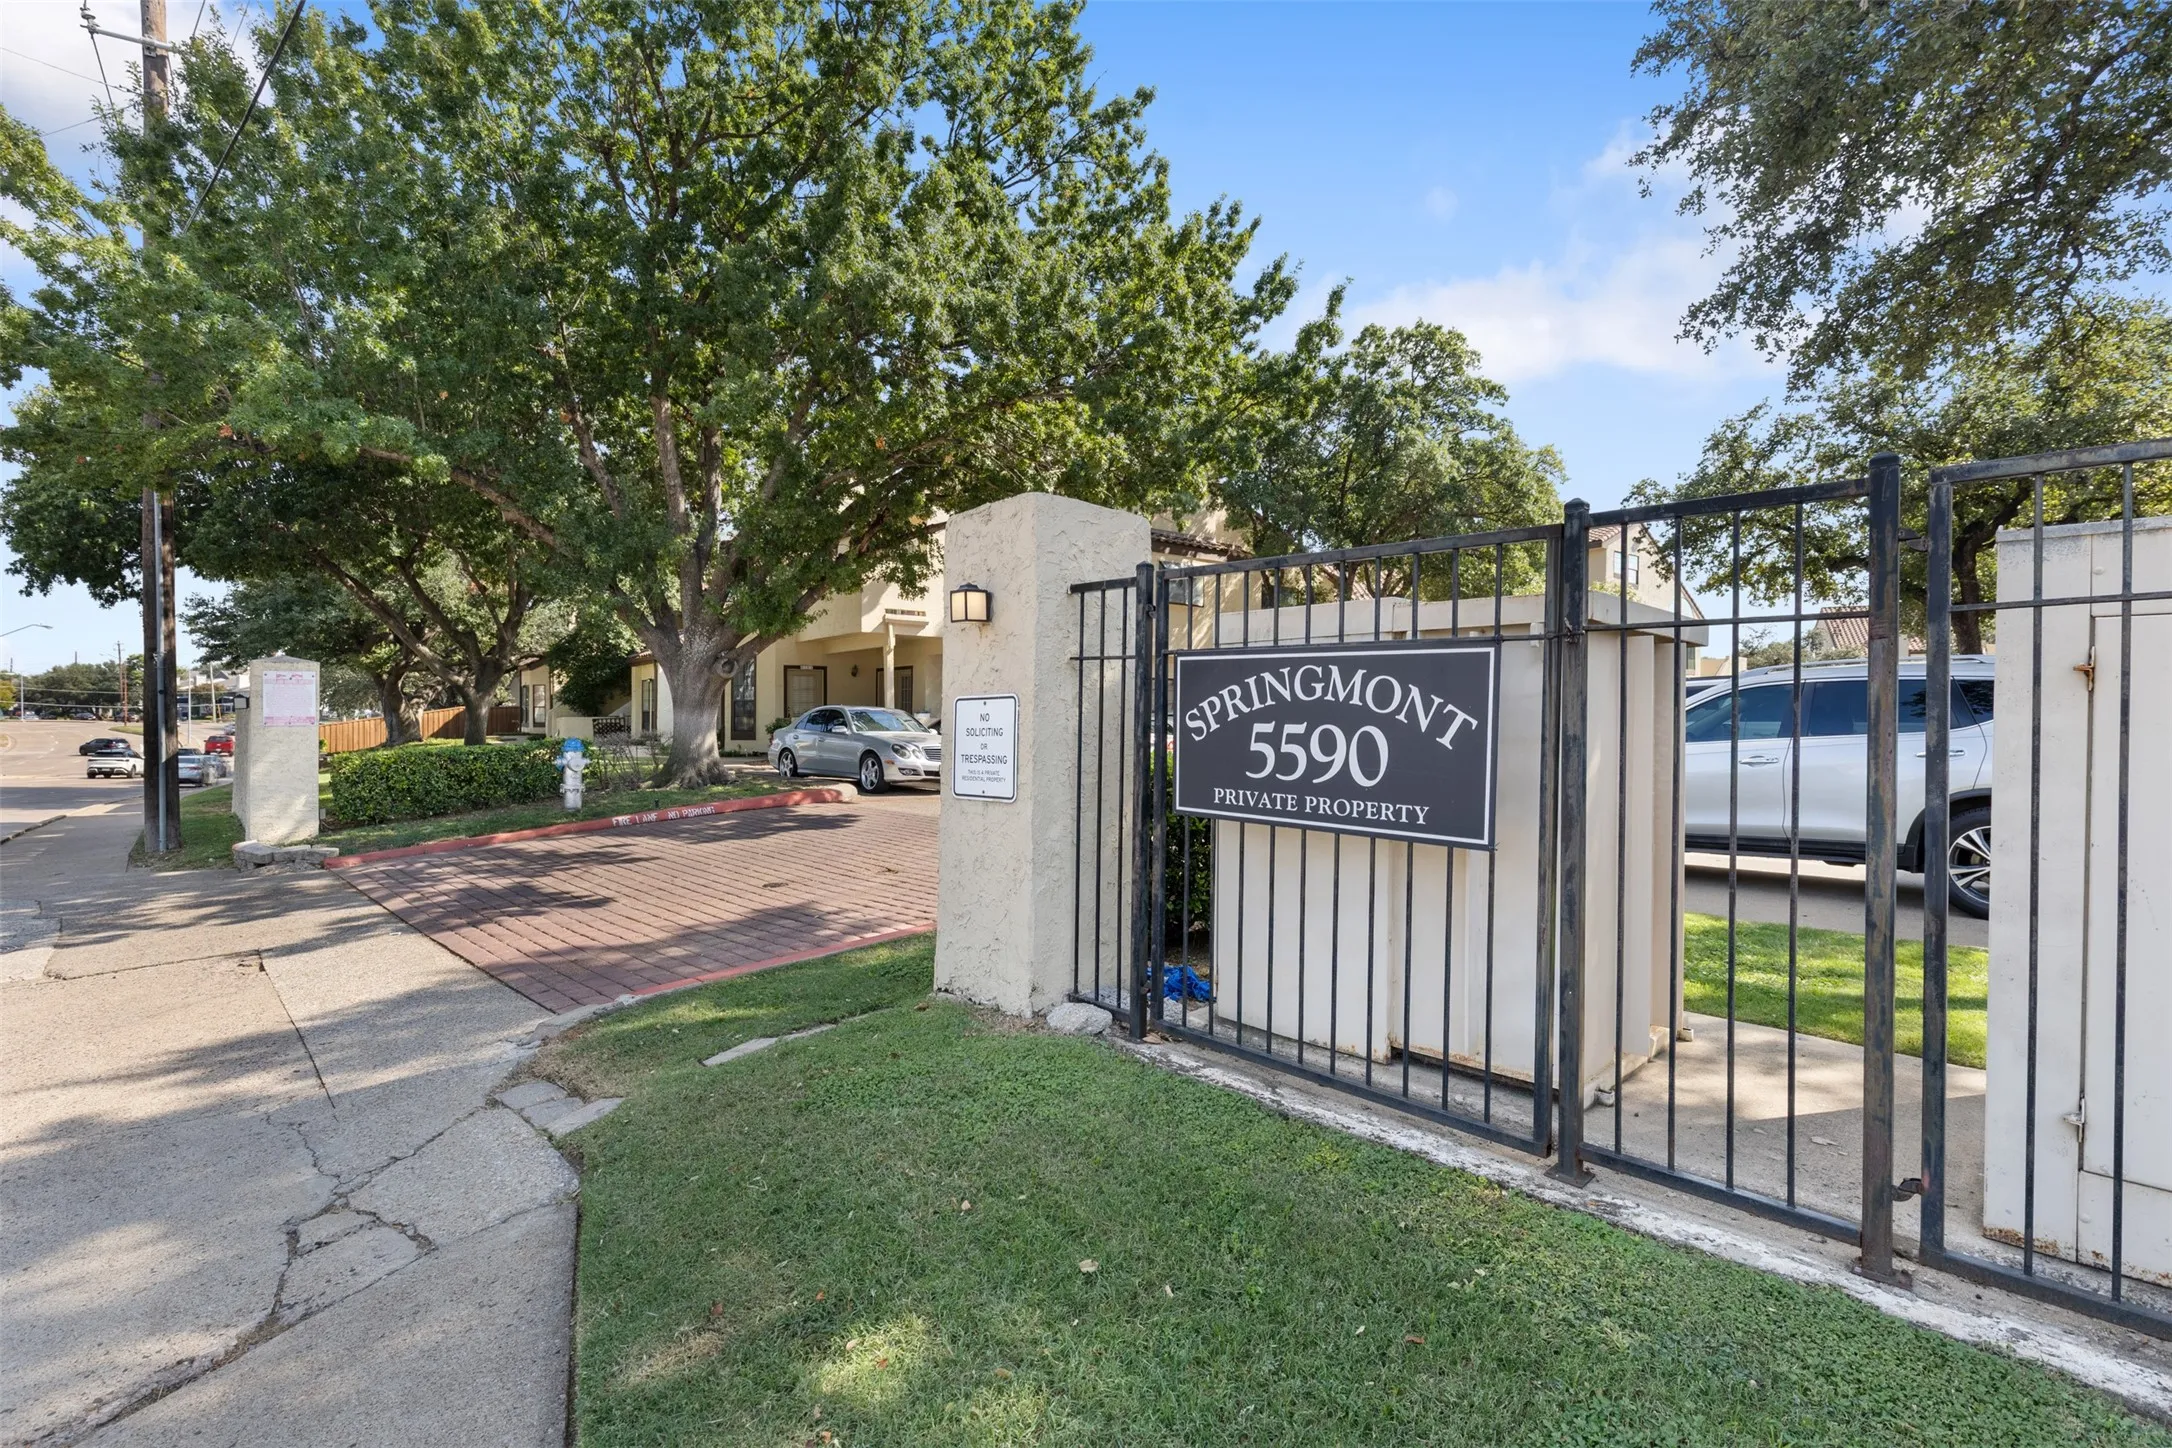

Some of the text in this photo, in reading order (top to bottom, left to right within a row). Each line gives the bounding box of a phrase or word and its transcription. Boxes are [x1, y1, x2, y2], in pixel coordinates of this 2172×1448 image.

[979, 713, 990, 722] NO
[1185, 664, 1478, 750] SPRINGMONT
[965, 727, 1004, 737] SOLICITING
[960, 754, 1008, 765] TRESPASSING
[1245, 720, 1389, 788] 5590
[612, 816, 633, 827] FIRE
[668, 810, 680, 820] NO
[682, 806, 716, 818] PARKING
[1213, 787, 1430, 825] PRIVATE PROPERTY
